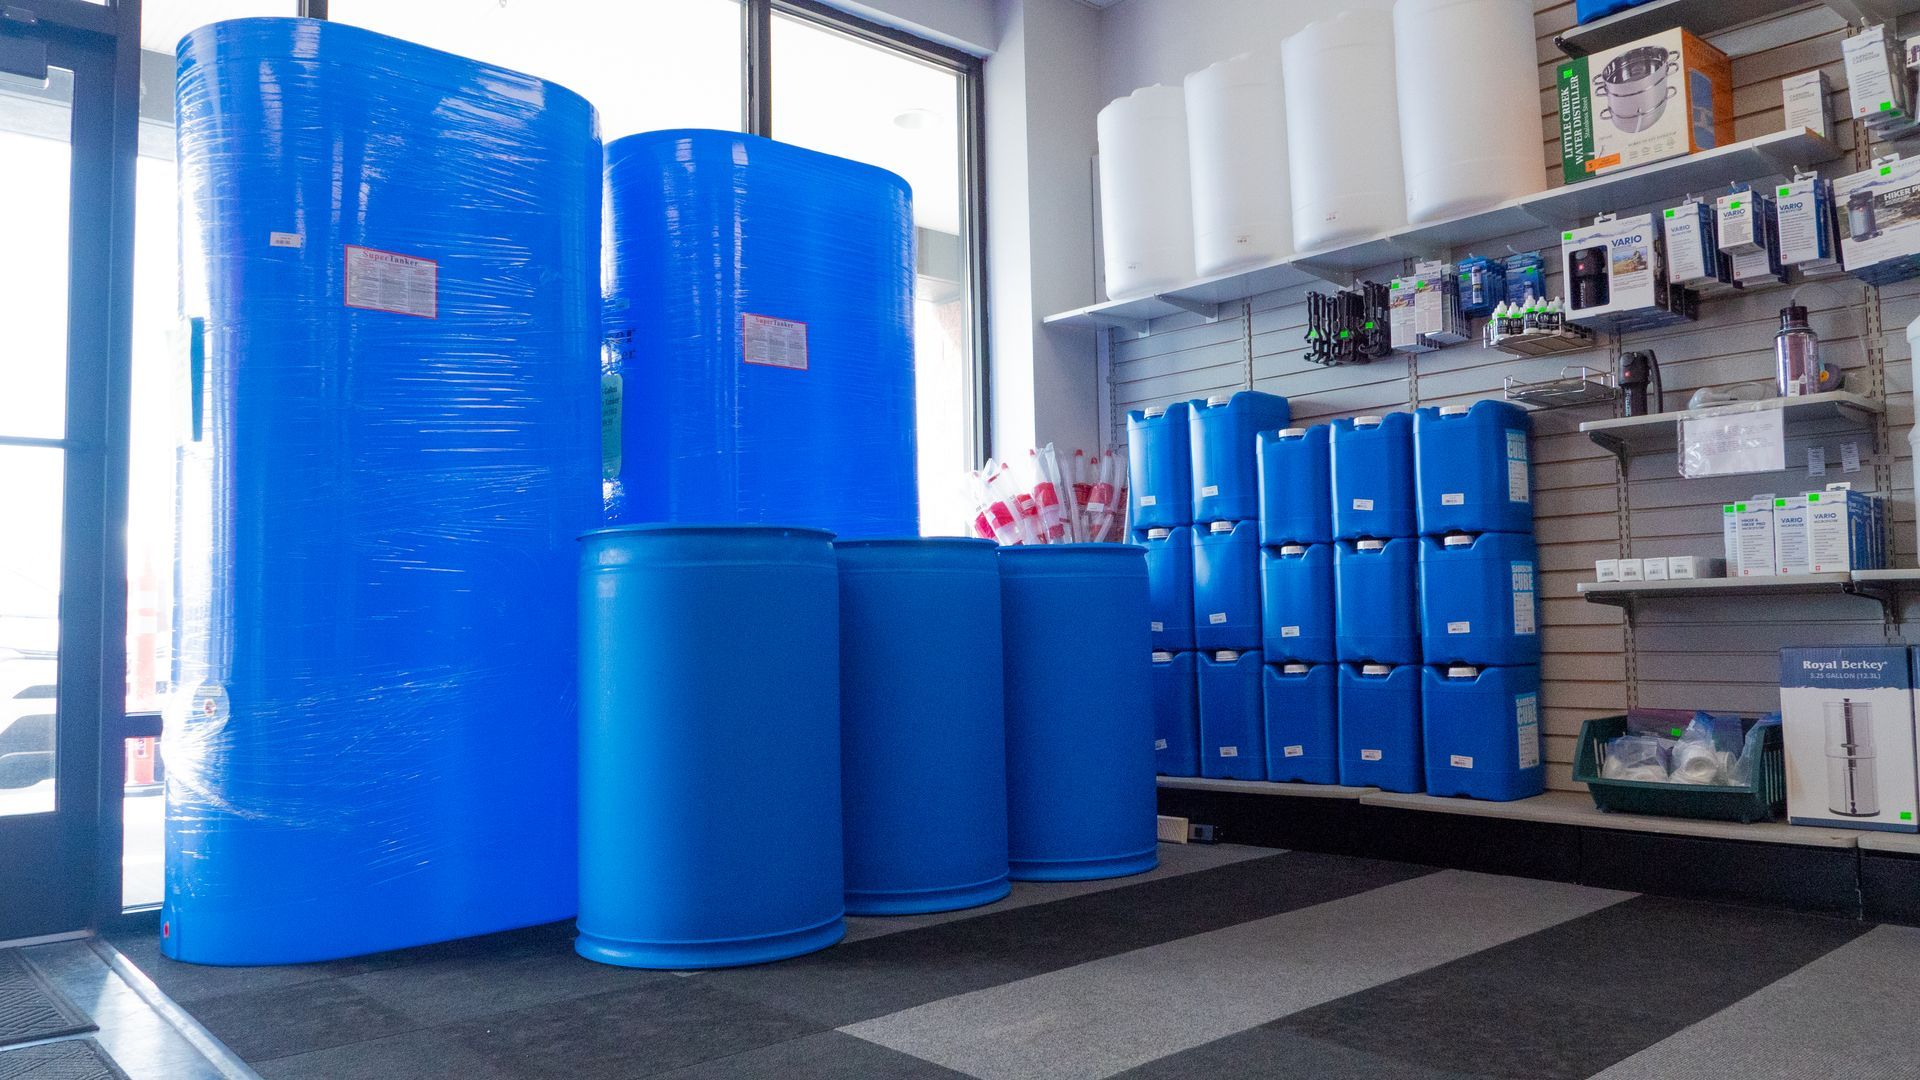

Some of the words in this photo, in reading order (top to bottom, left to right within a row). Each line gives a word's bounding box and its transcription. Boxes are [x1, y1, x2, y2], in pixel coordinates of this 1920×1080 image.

[1561, 86, 1571, 123] CREEK
[1570, 75, 1583, 128] DISTILLER
[1563, 124, 1574, 159] LITTLE
[1574, 129, 1584, 165] WATER
[1884, 188, 1911, 201] HIKER
[1723, 209, 1745, 217] VARIO
[1779, 202, 1803, 211] VARIO
[1671, 224, 1690, 233] VARIO
[1612, 235, 1642, 247] VARIO
[362, 250, 419, 267] SuperTanker
[755, 316, 794, 329] SuperTanker
[1507, 440, 1527, 460] CUBE
[1512, 573, 1533, 591] CUBE
[1803, 660, 1837, 671] Royal
[1857, 672, 1881, 680] (12.3L)
[1517, 704, 1537, 725] CUBE
